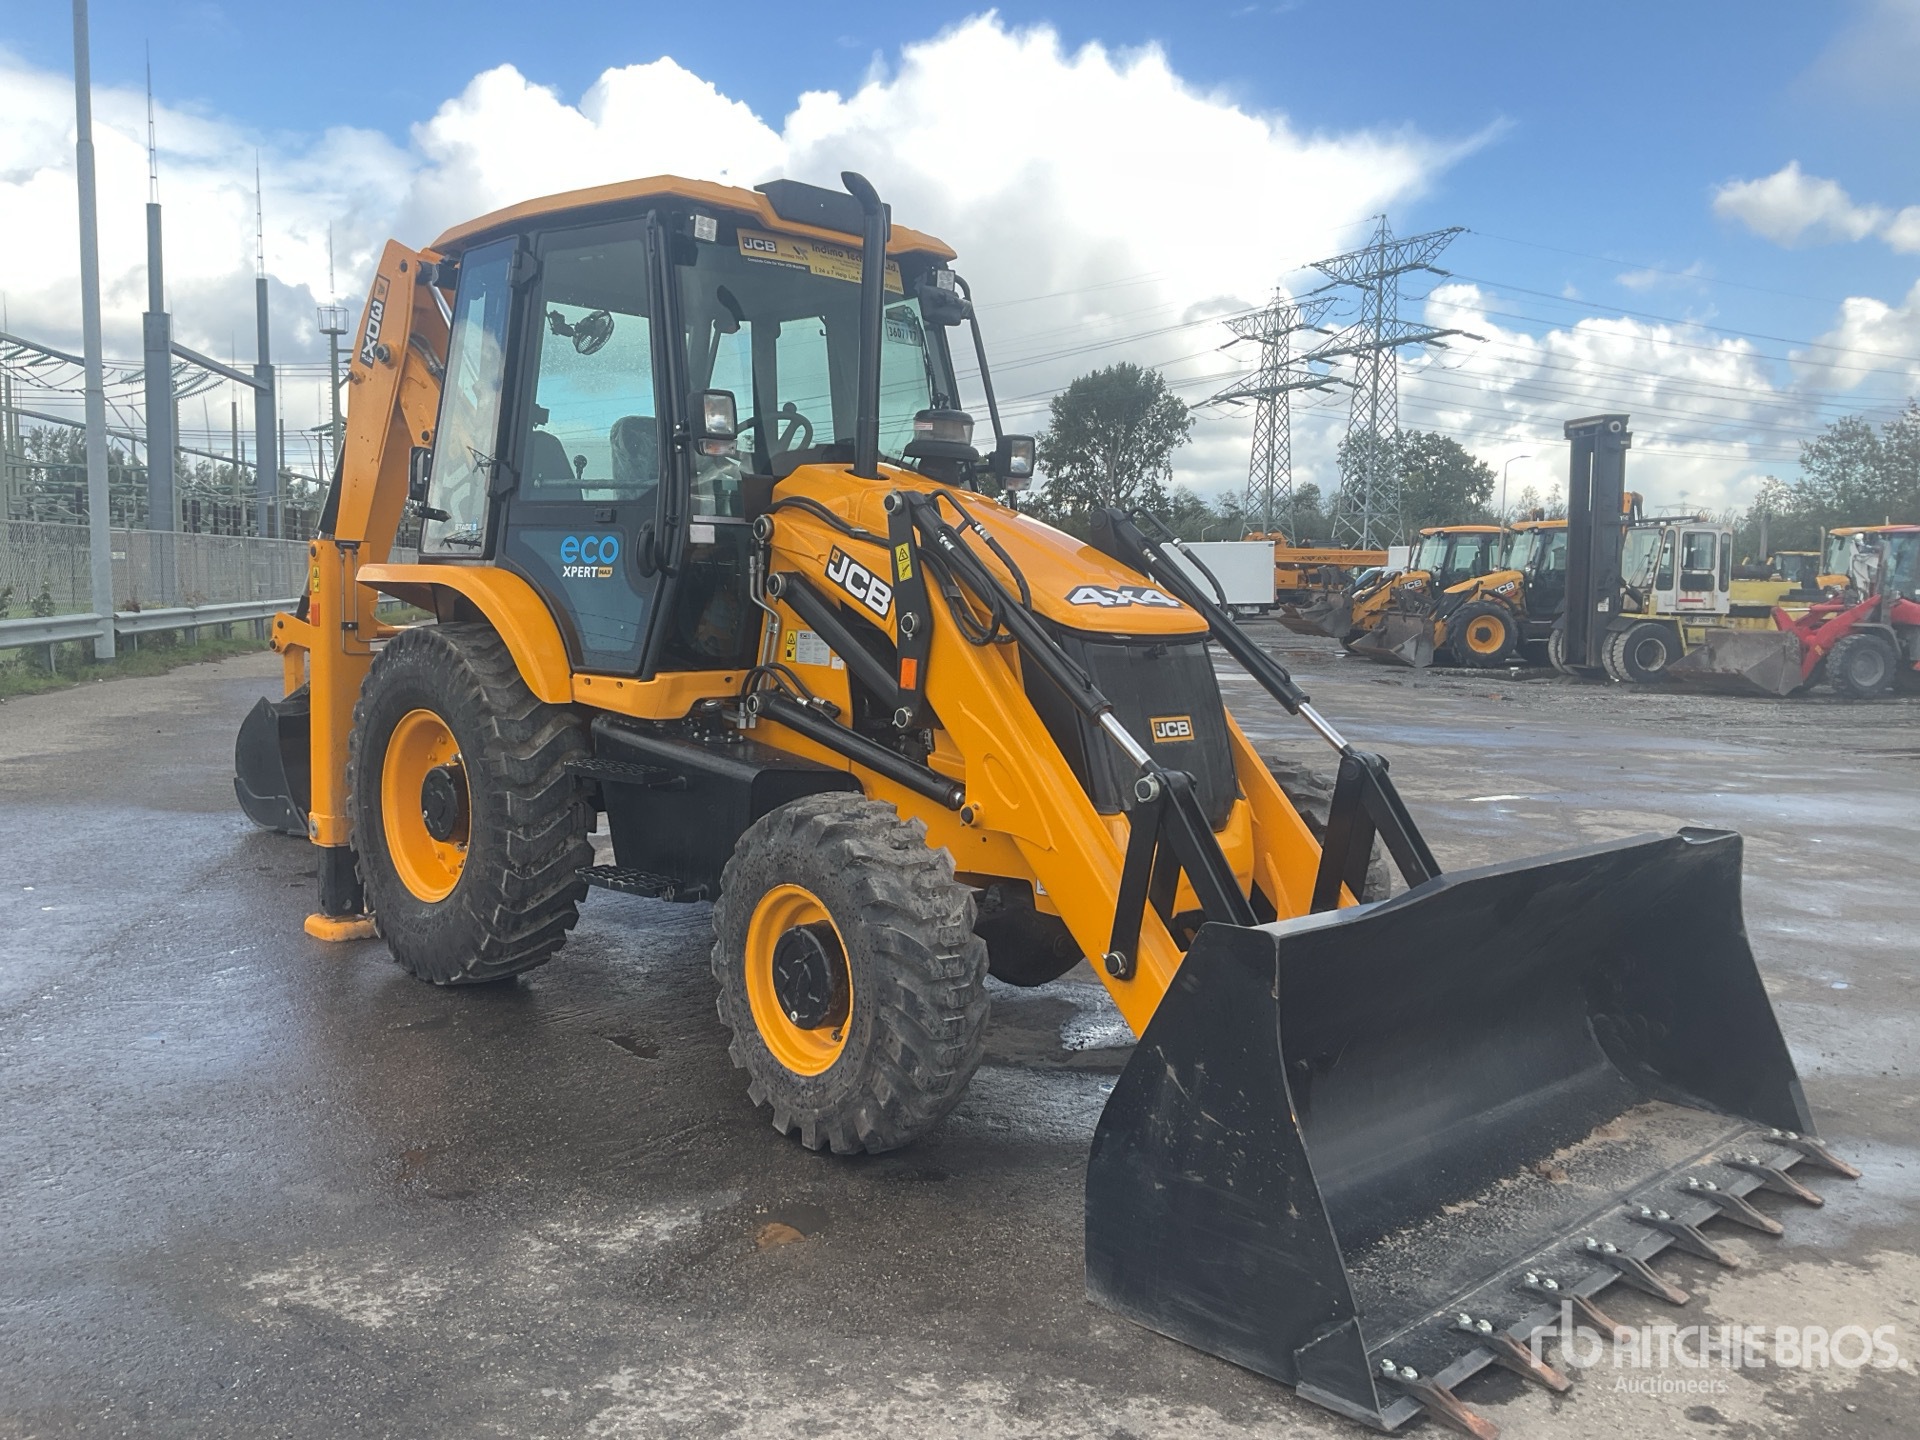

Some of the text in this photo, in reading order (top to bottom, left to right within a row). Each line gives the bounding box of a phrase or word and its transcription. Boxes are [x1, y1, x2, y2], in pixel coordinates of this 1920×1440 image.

[744, 238, 776, 252] JCB
[811, 243, 843, 257] Indimo
[362, 300, 384, 358] 3DX
[560, 535, 619, 565] eco
[562, 565, 598, 578] XPERT
[827, 555, 892, 615] JCB
[1494, 581, 1515, 594] CB
[1156, 721, 1190, 738] JCB
